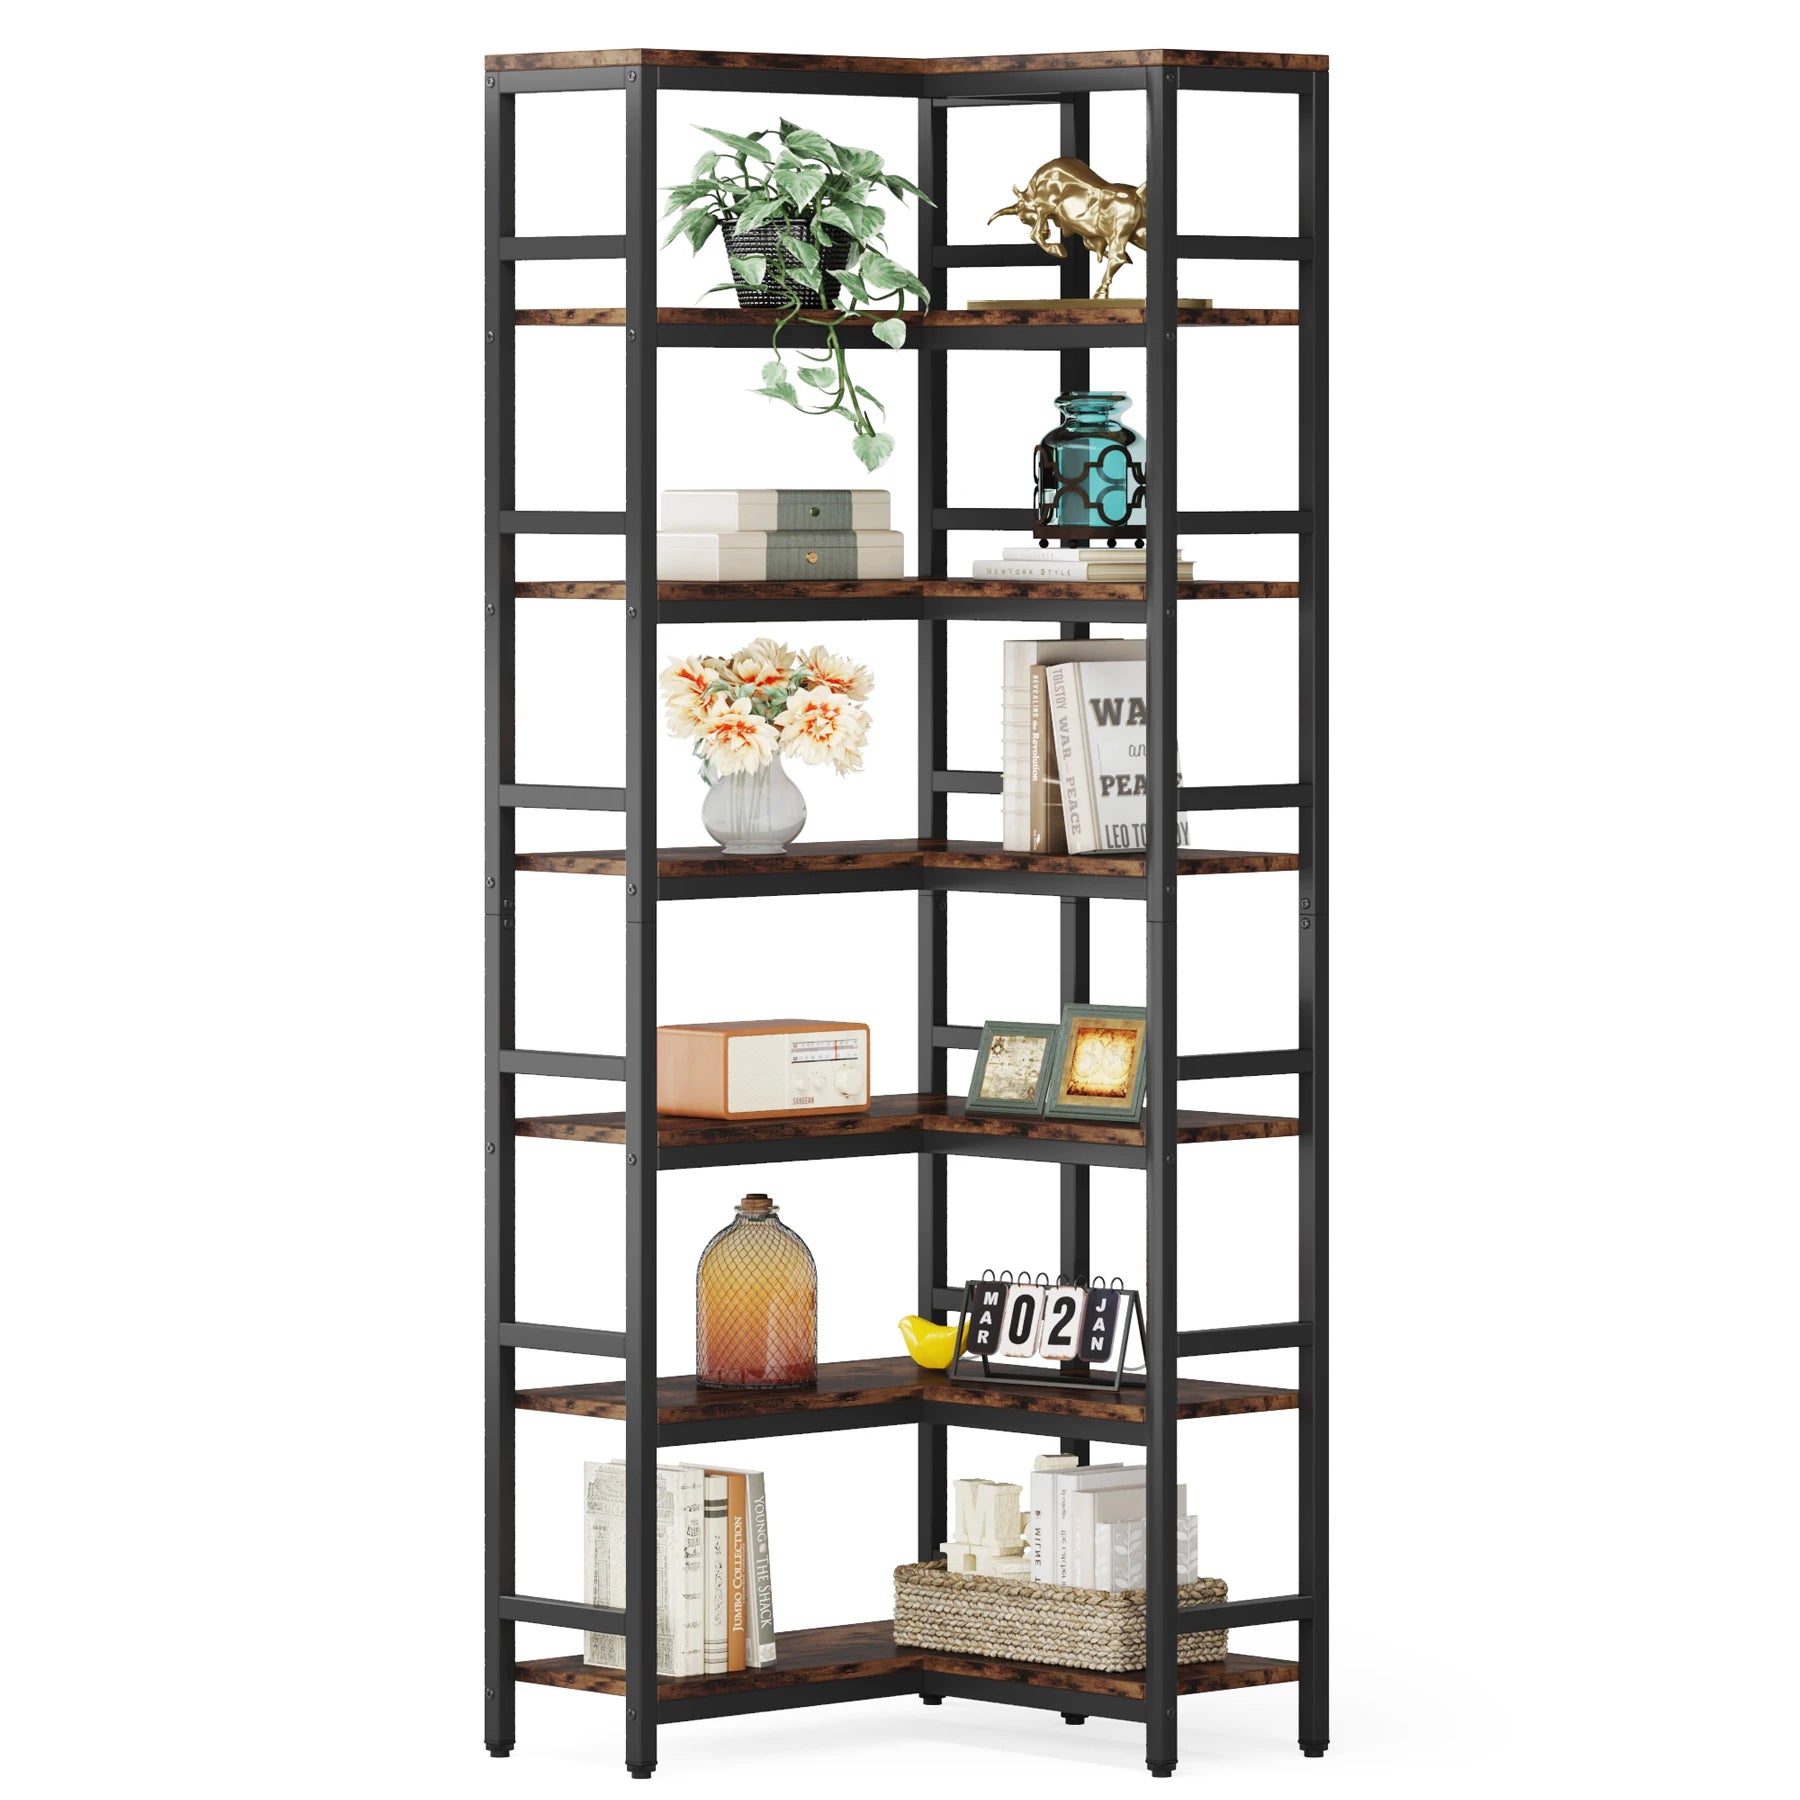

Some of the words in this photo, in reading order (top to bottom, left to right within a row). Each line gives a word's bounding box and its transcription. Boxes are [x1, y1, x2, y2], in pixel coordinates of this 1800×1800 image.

[1052, 668, 1068, 709] TOLSTOY
[1090, 697, 1146, 727] WA
[1032, 732, 1040, 781] Revolution
[1059, 716, 1072, 760] WAR
[1128, 743, 1147, 758] an
[1066, 776, 1081, 835] PEACE
[1105, 823, 1130, 849] LEO
[977, 1291, 999, 1344] MAR
[1090, 1298, 1107, 1351] JAN
[754, 1495, 767, 1542] YOUNG
[756, 1555, 769, 1582] THE
[758, 1585, 772, 1629] SHACK
